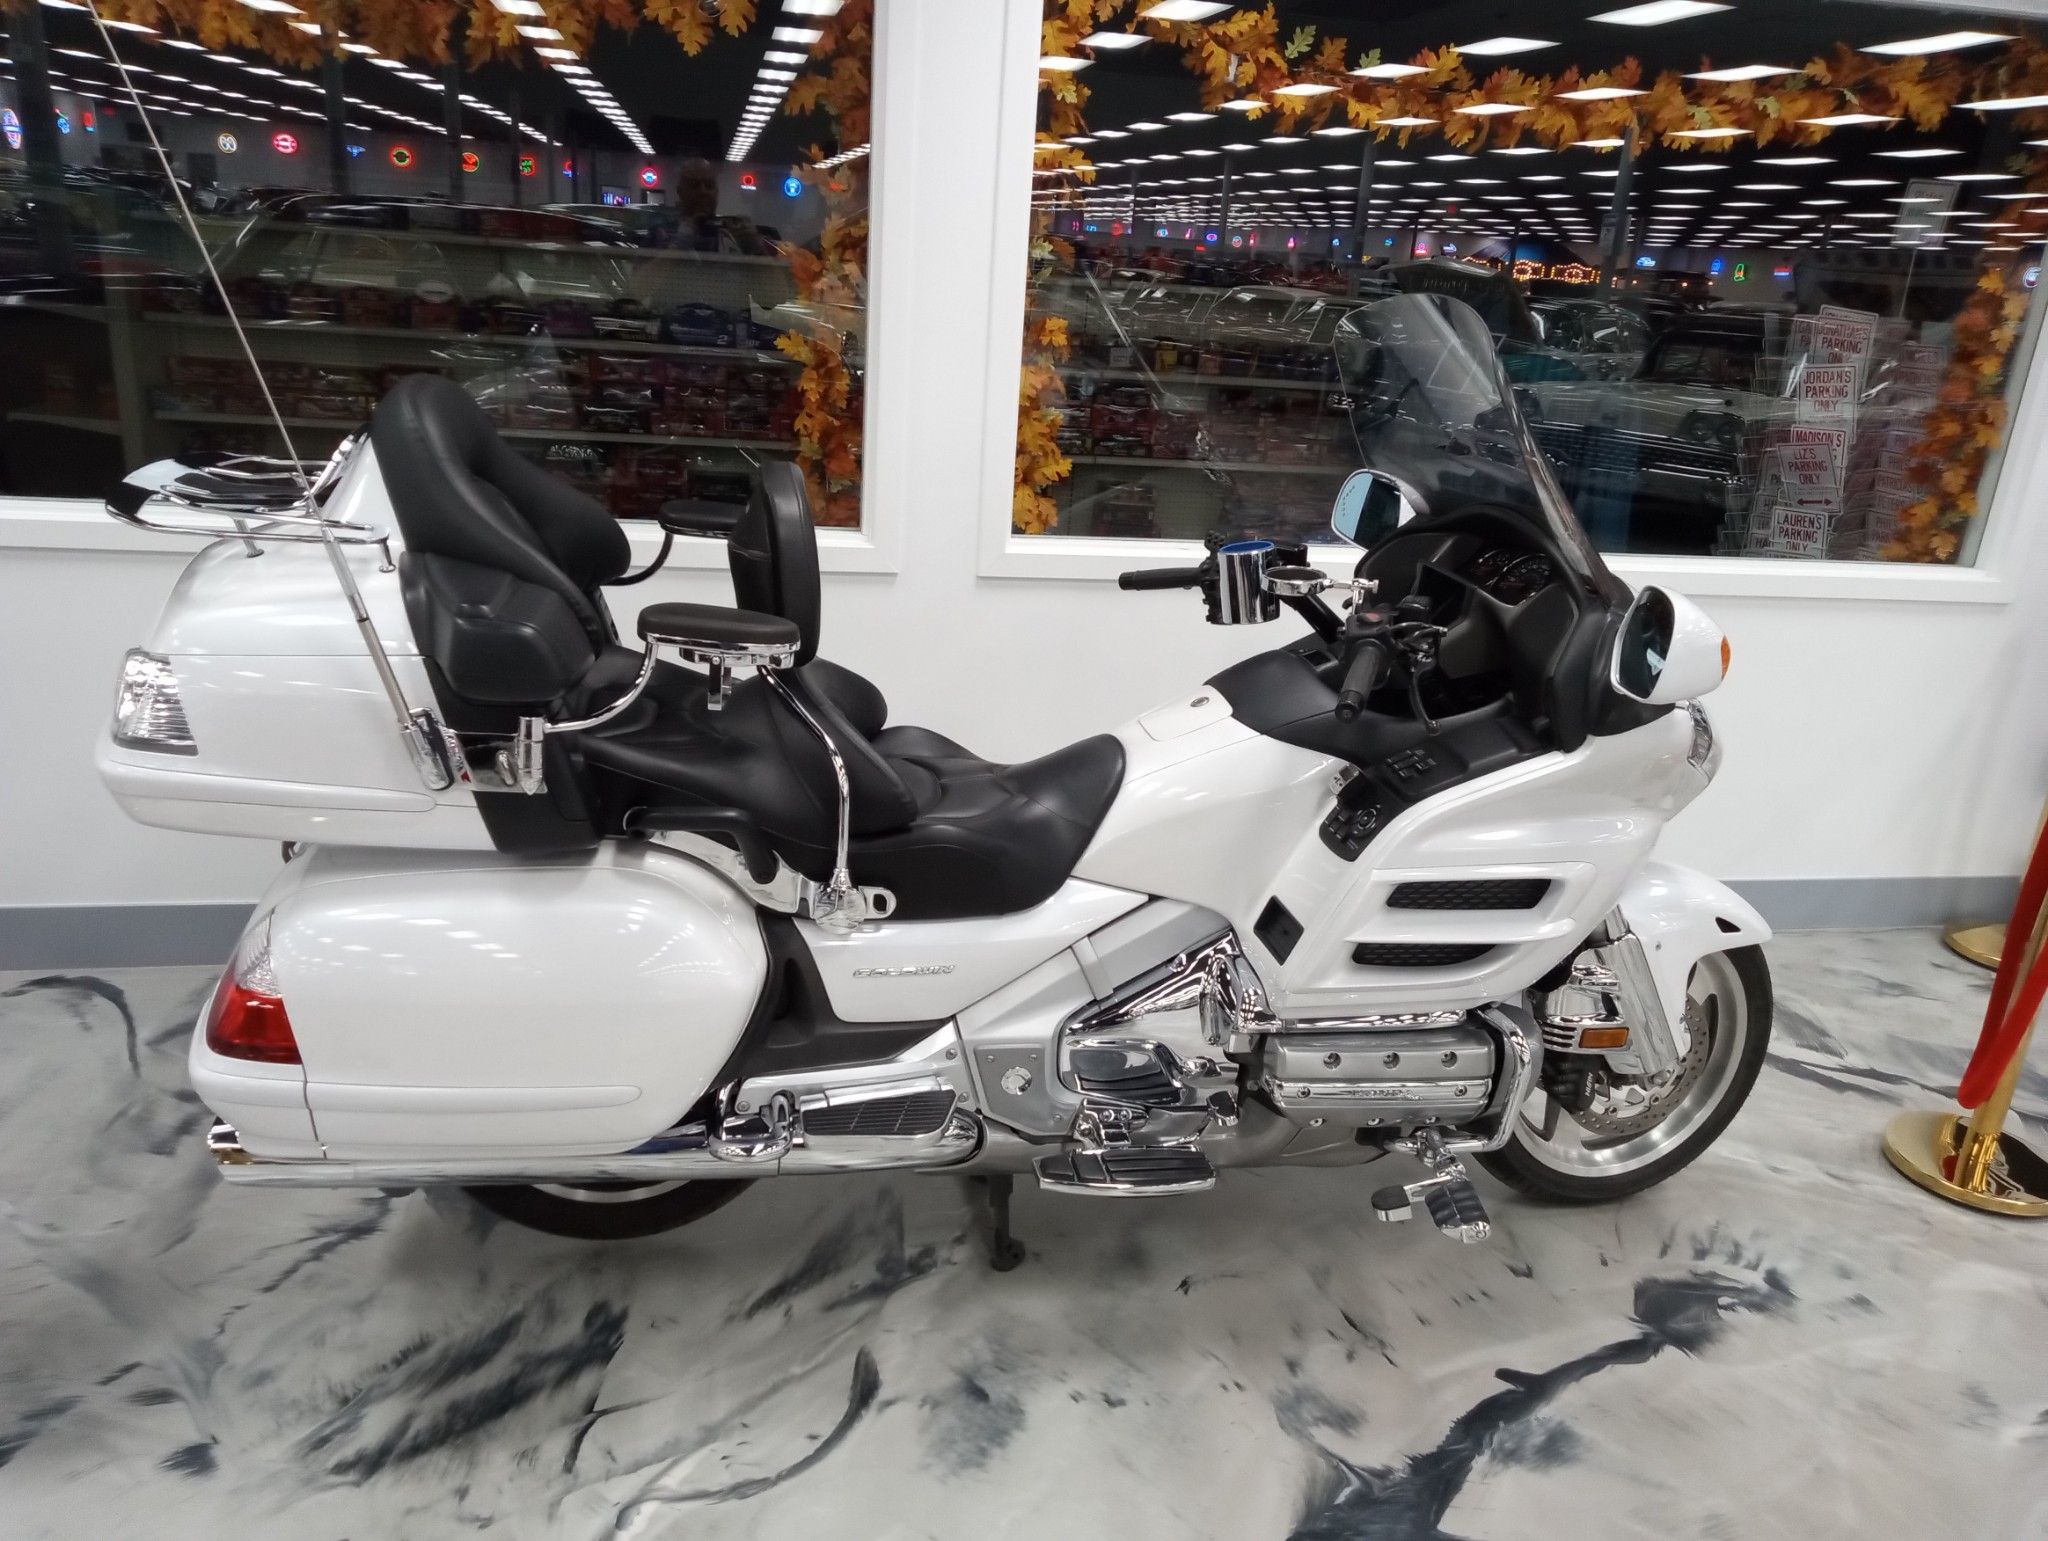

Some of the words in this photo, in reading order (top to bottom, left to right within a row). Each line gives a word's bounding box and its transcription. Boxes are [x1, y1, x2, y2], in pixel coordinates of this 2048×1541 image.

[1821, 336, 1862, 354] PARKING
[1805, 385, 1849, 399] PARKING
[1814, 400, 1839, 412] ONLY
[1788, 460, 1828, 472] PARKING
[1798, 473, 1821, 485] ONLY
[1779, 526, 1818, 544] PARKING
